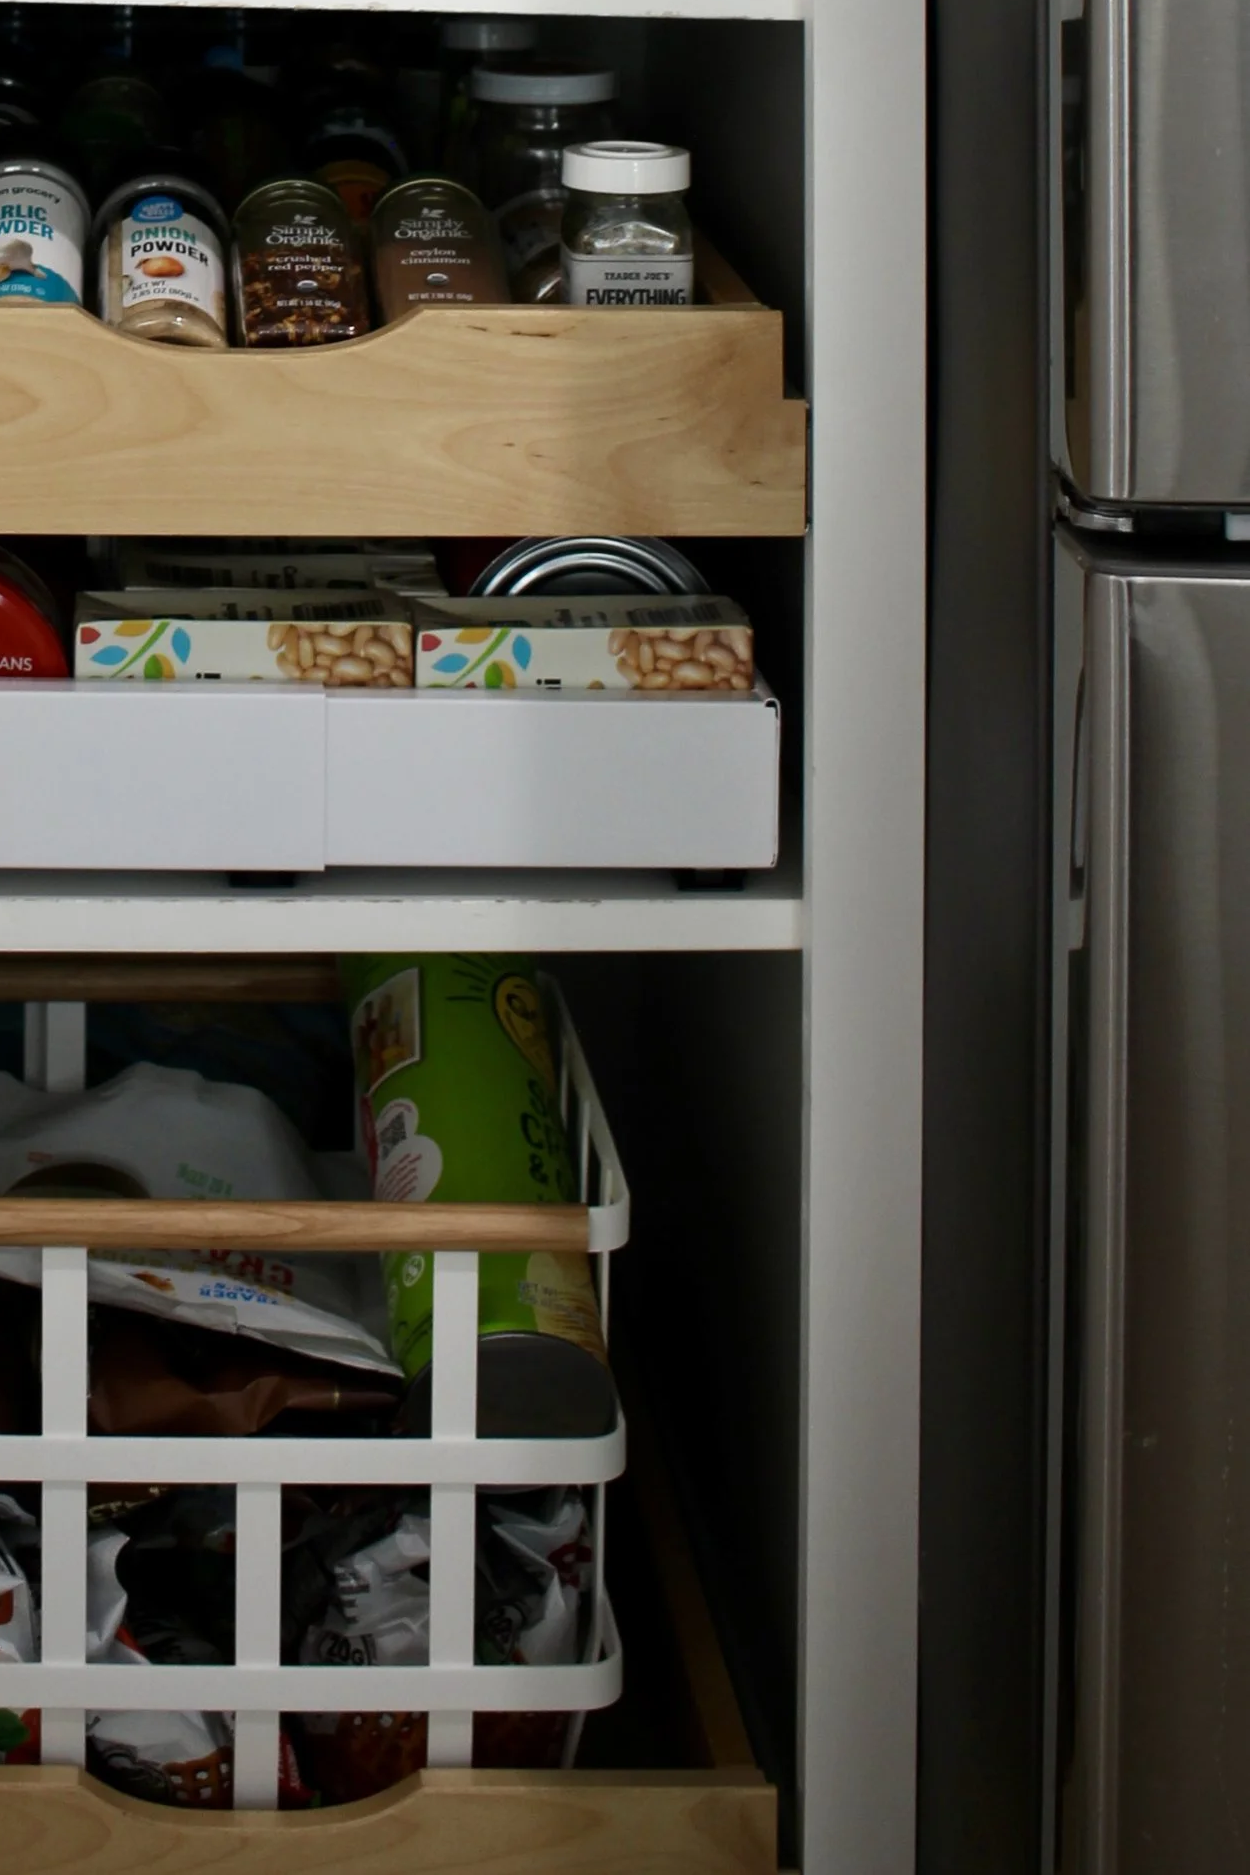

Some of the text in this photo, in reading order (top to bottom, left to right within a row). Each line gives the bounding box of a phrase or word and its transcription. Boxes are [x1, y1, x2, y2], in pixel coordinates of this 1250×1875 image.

[11, 186, 61, 205] grocery
[399, 218, 465, 231] Simply
[131, 226, 196, 246] ONION
[271, 225, 336, 238] Simply
[394, 228, 472, 241] Organic
[265, 232, 343, 247] Organic
[131, 240, 209, 267] POWDER
[409, 247, 456, 257] ceylon
[275, 254, 332, 264] crushed
[401, 256, 471, 266] cinnamon
[268, 263, 344, 274] red pepper
[604, 272, 671, 281] TRADER JOE'S
[586, 288, 686, 305] EVERYTHING
